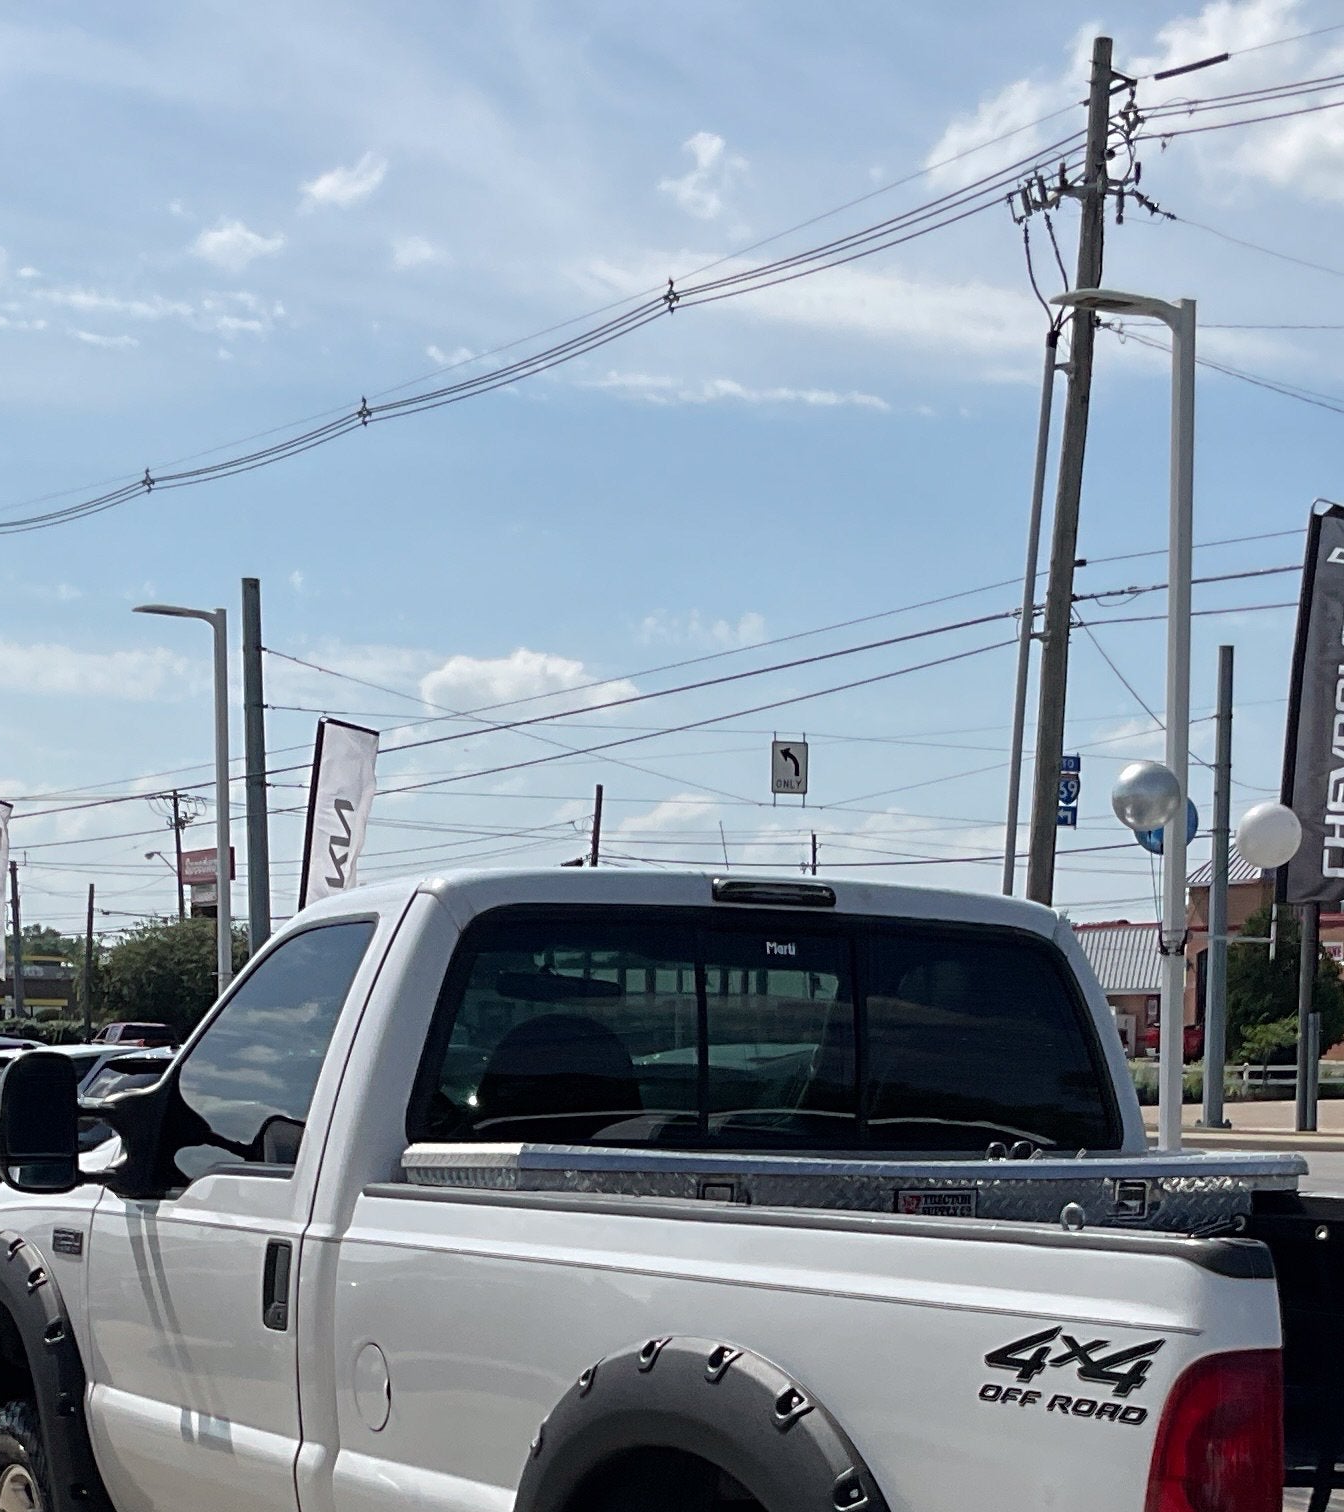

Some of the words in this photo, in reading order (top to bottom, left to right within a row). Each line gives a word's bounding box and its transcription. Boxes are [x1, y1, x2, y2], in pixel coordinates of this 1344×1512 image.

[776, 779, 803, 790] ONLY
[1059, 780, 1078, 799] 69
[978, 1383, 1043, 1408] OFF
[1046, 1393, 1149, 1426] ROAD
